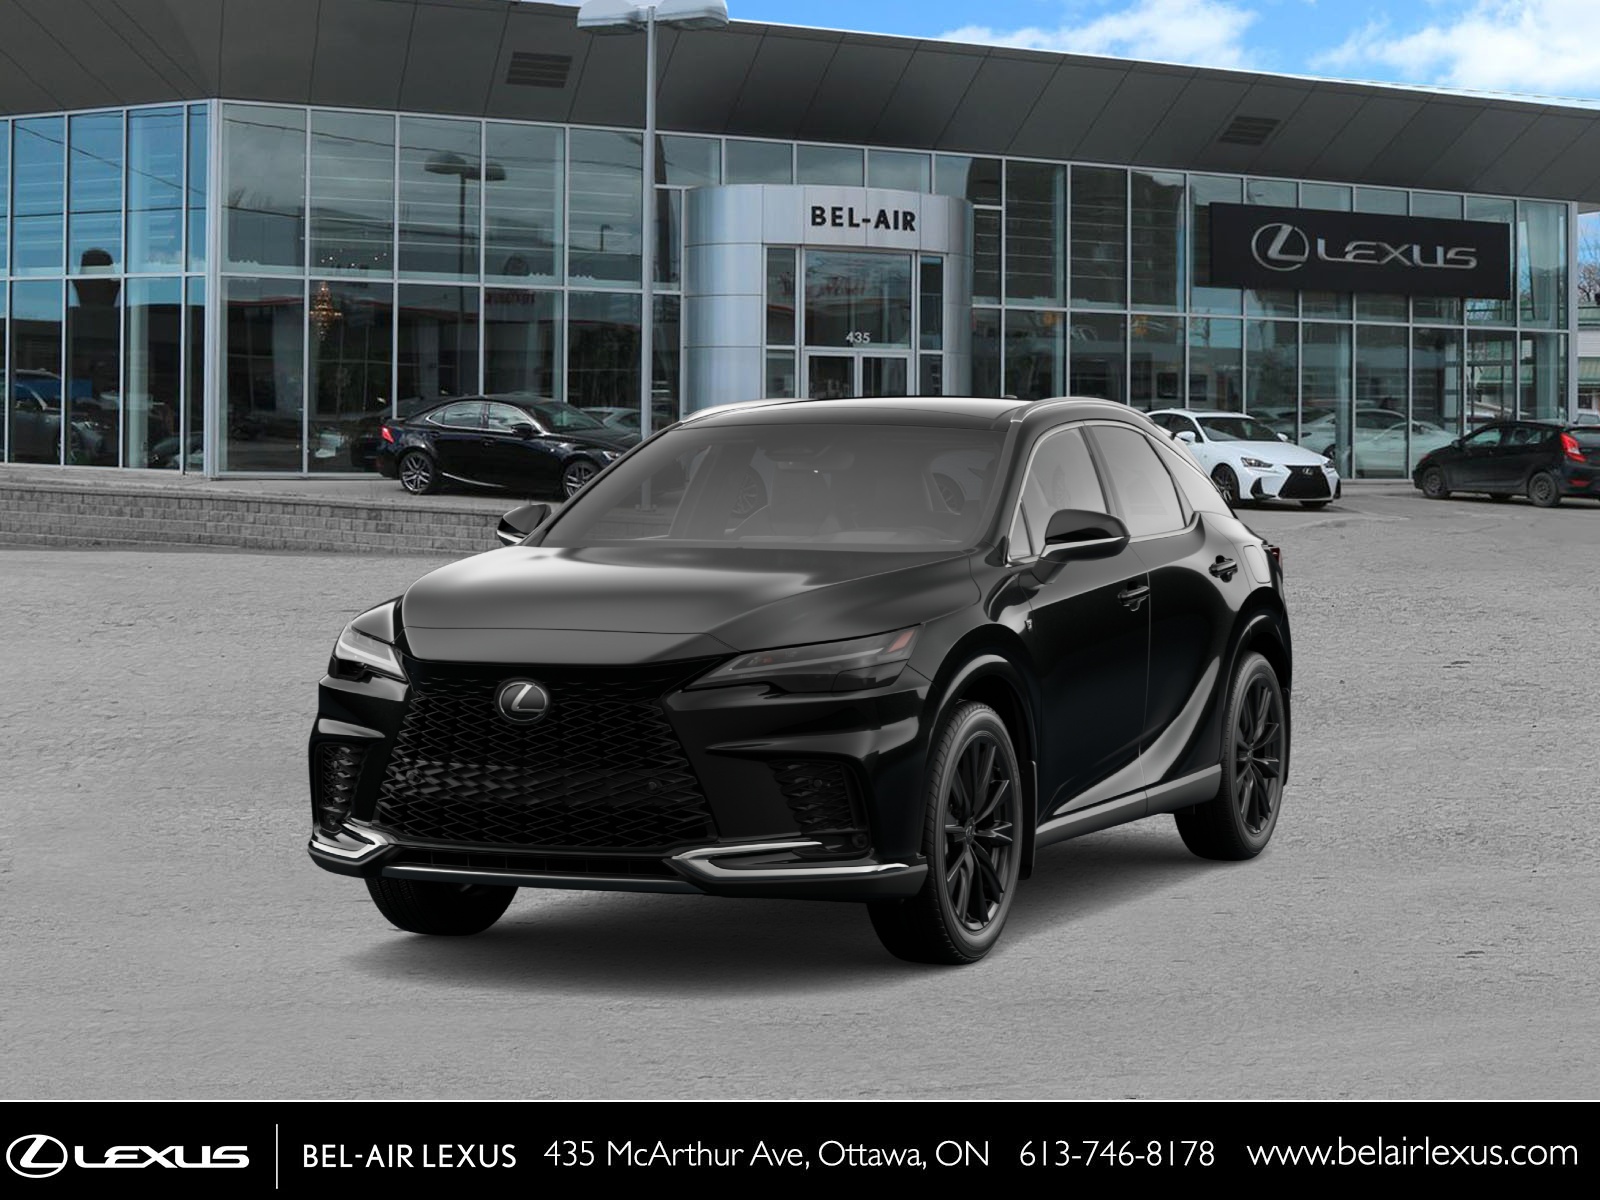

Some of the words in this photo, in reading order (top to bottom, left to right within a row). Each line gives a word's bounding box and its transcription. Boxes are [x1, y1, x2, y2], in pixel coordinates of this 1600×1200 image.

[811, 205, 916, 232] BEL-AIR
[1316, 237, 1478, 270] LEXUS
[845, 331, 871, 344] 435
